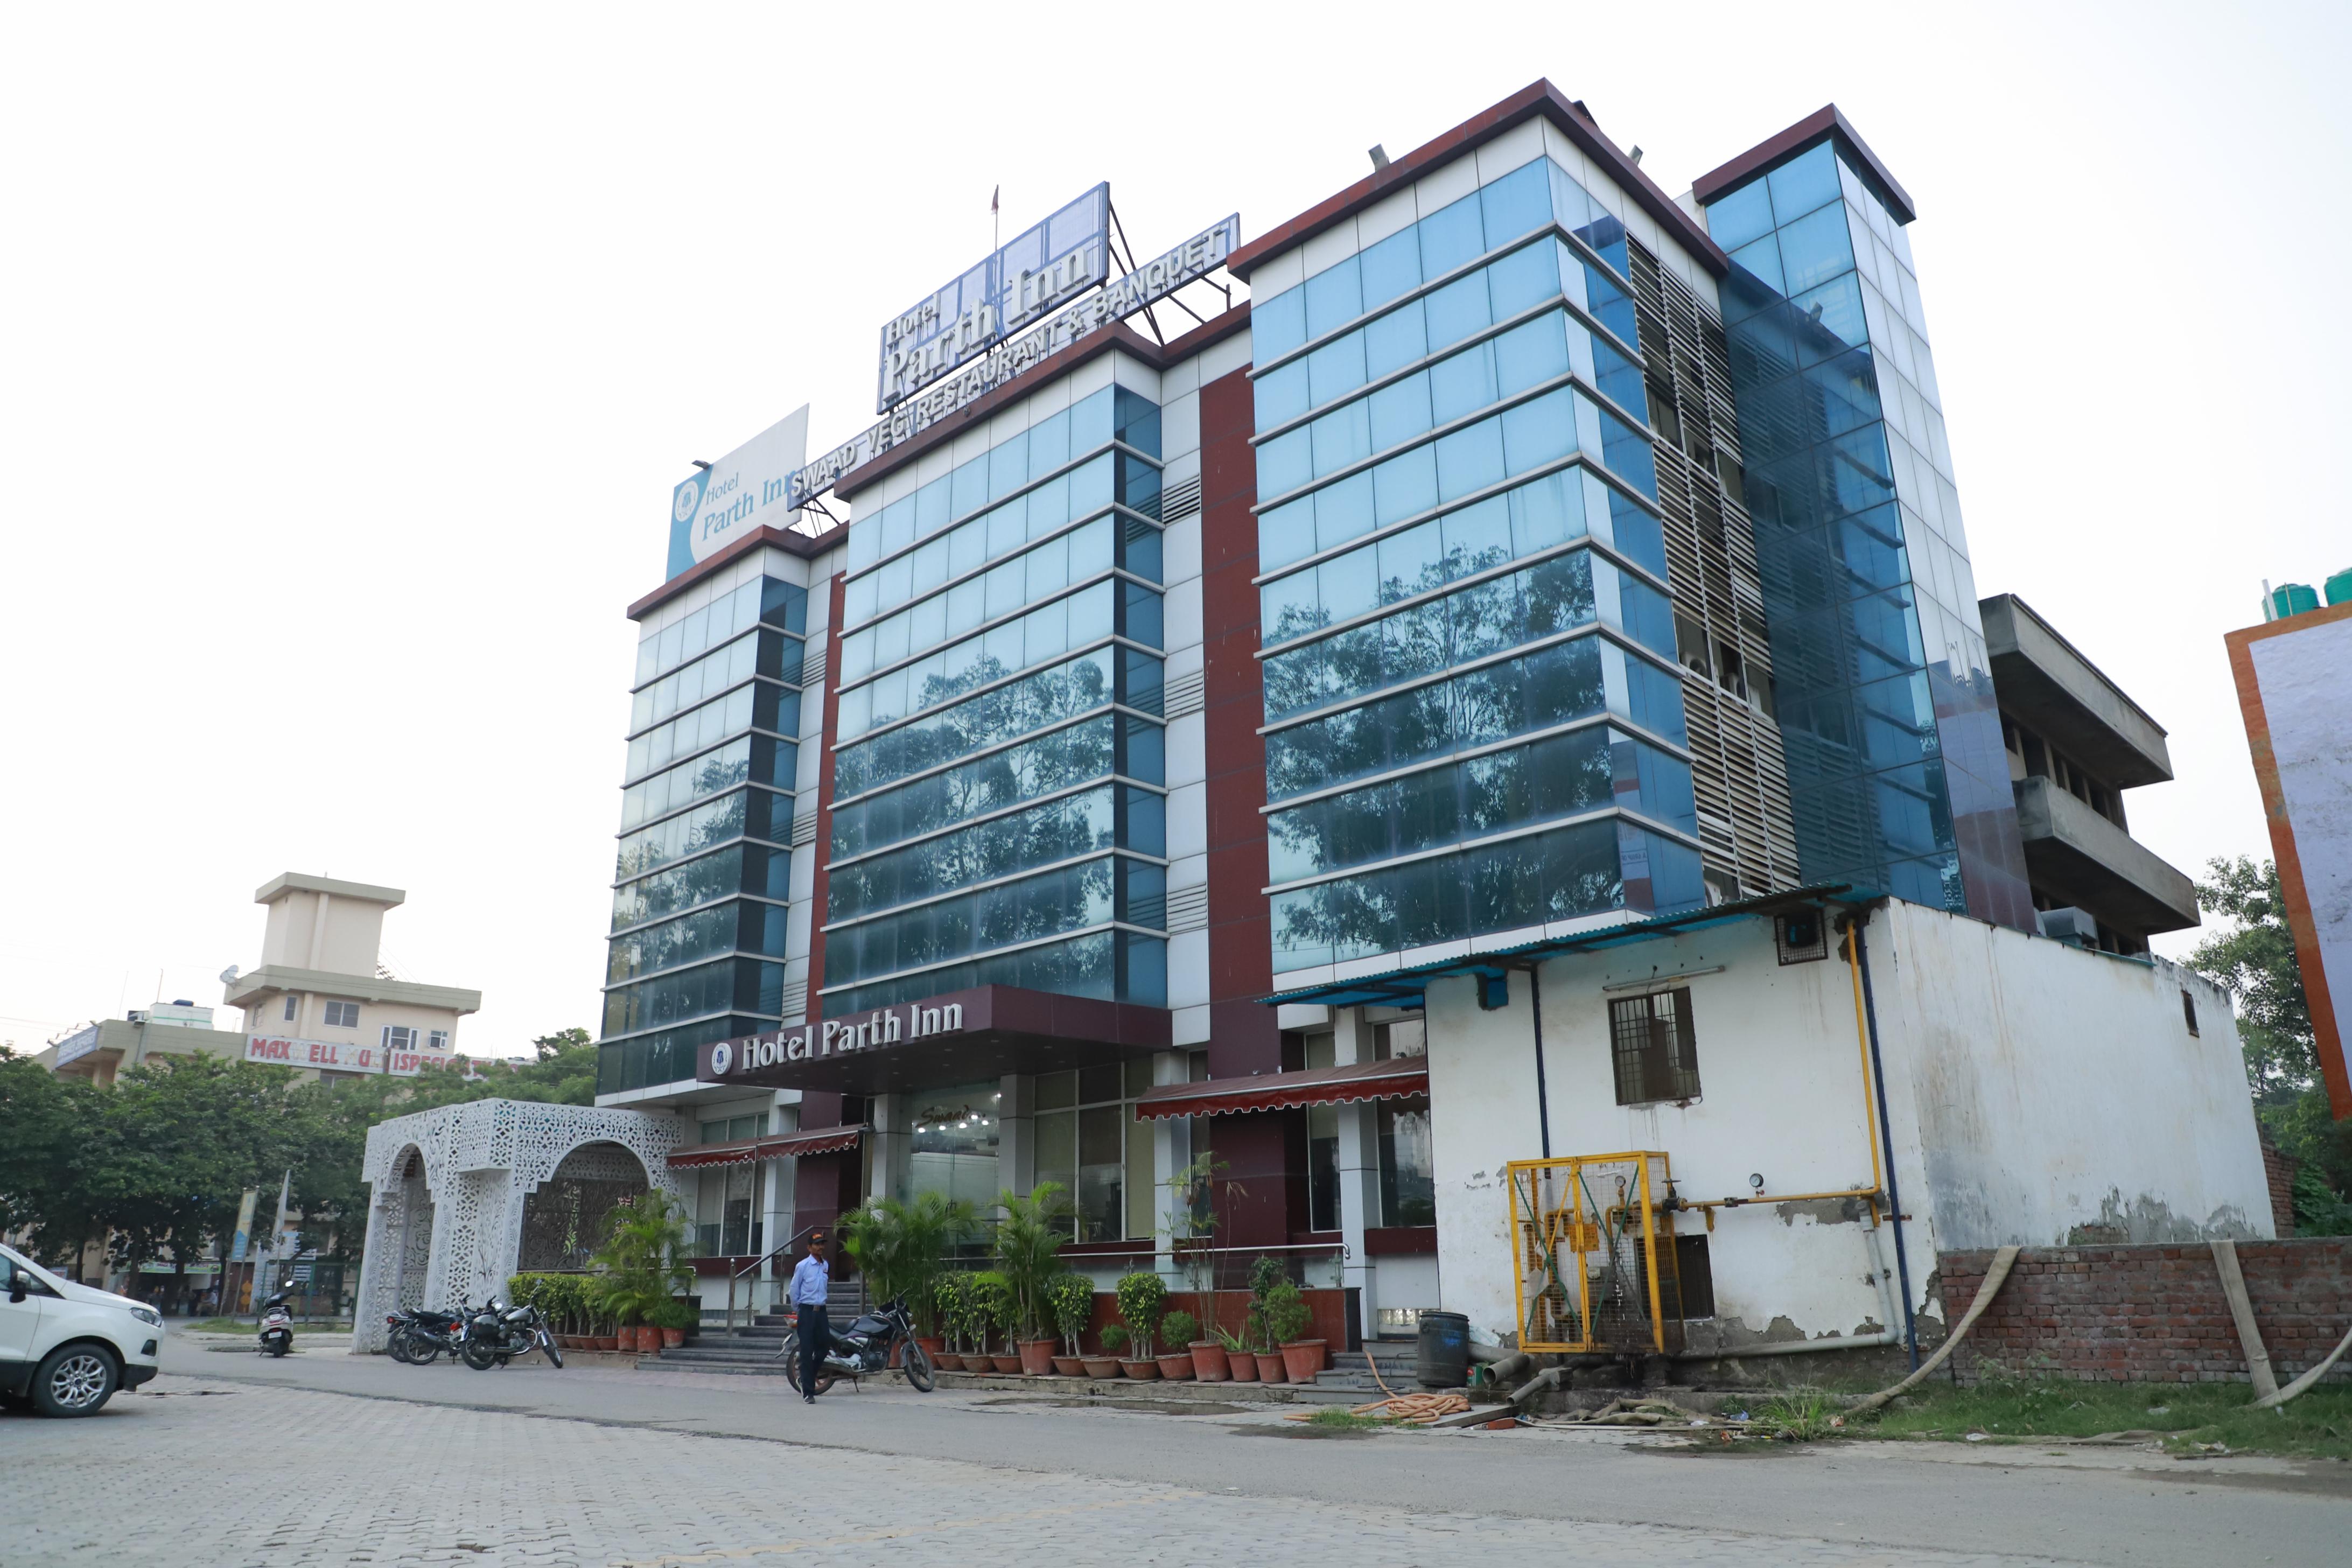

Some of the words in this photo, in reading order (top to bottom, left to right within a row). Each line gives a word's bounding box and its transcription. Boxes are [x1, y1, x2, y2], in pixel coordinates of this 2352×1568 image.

[883, 298, 997, 402] Parth
[1008, 247, 1090, 325] Inn
[886, 292, 940, 346] Hotel
[791, 443, 858, 498] SWAAD
[916, 317, 1062, 424] RESTAURANT
[1068, 307, 1086, 335] &
[1092, 226, 1223, 322] BANQUET
[702, 492, 754, 542] Parth
[706, 472, 739, 505] Hotel
[741, 1025, 814, 1070] Hotel
[821, 1009, 901, 1056] Parth
[910, 1003, 964, 1038] Inn
